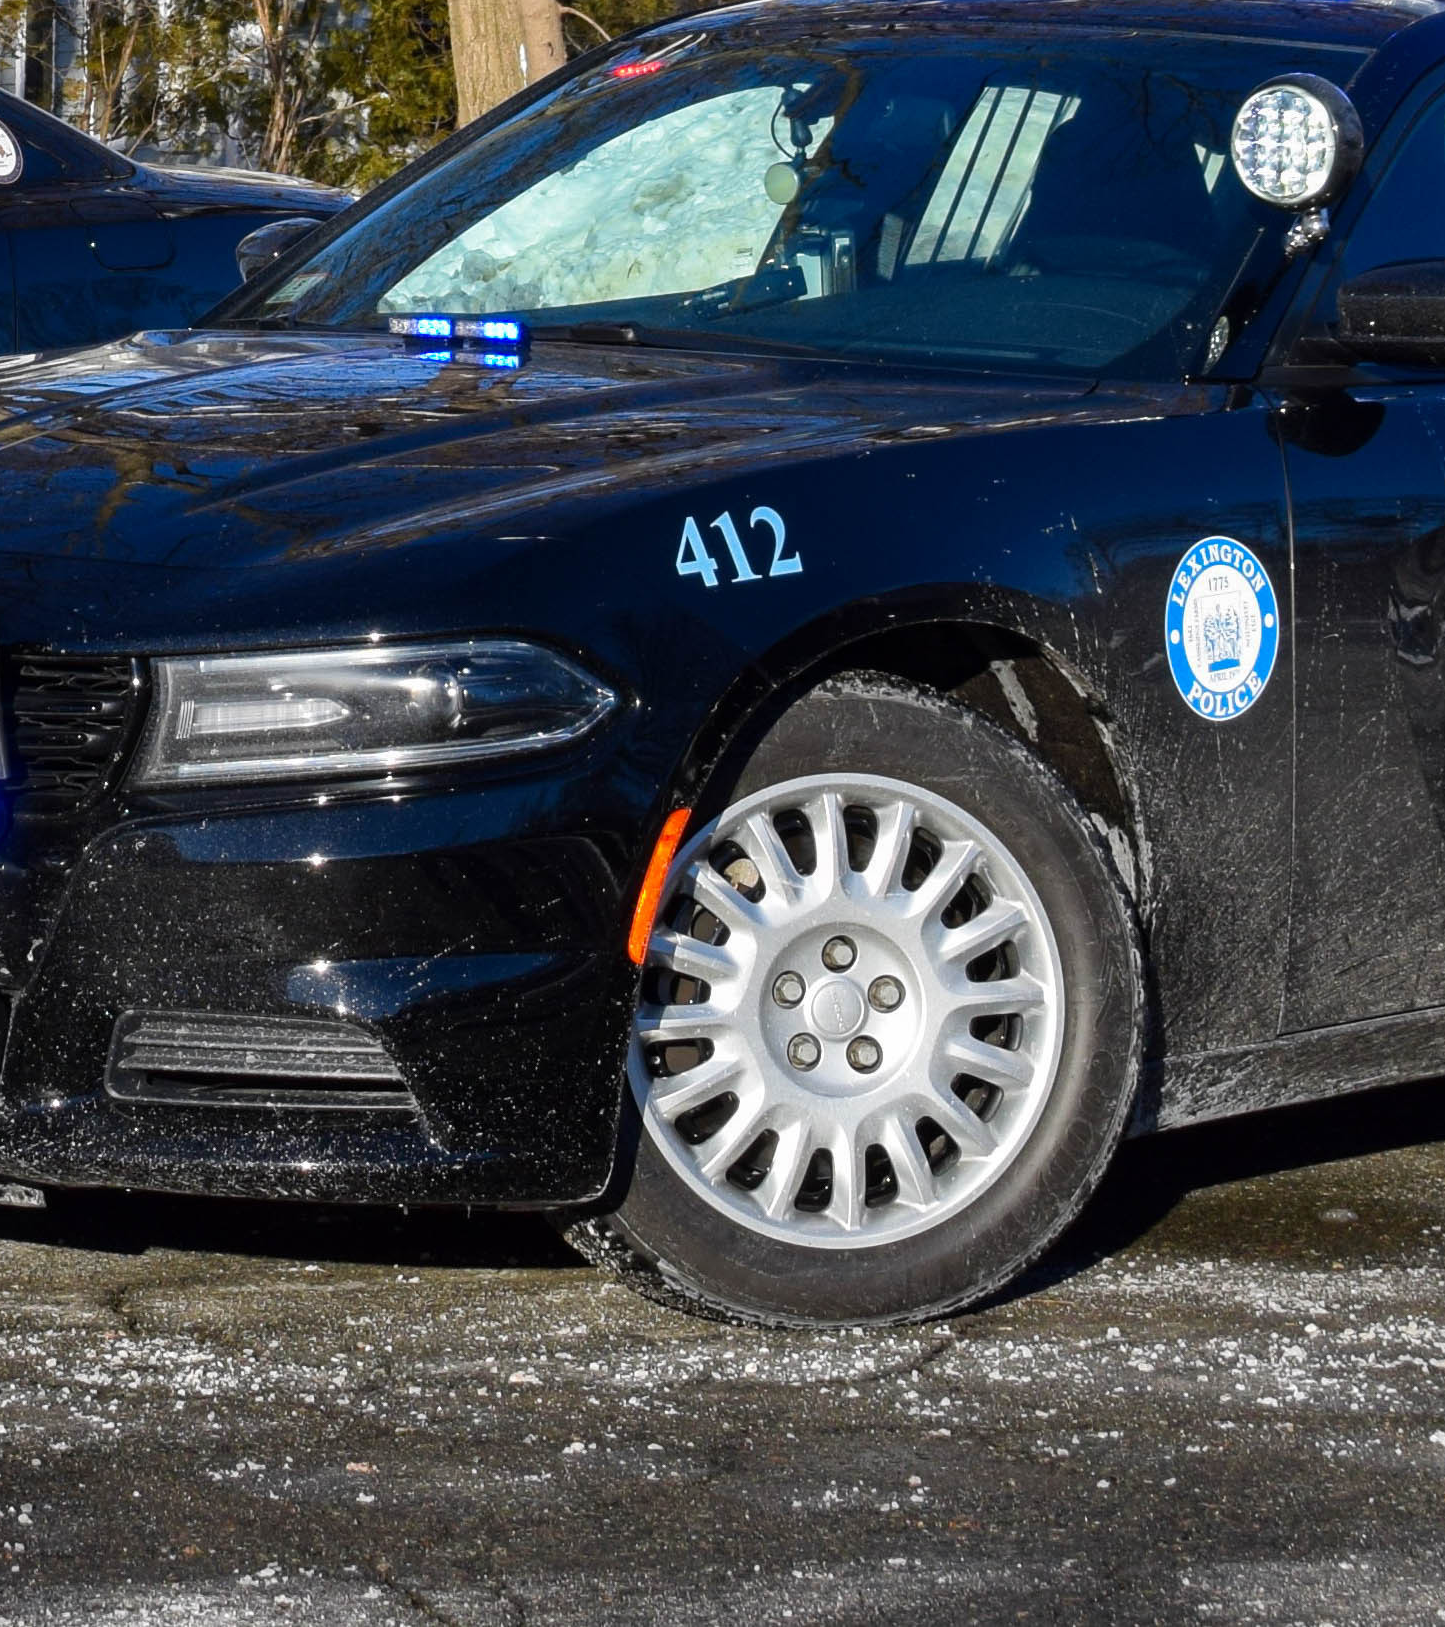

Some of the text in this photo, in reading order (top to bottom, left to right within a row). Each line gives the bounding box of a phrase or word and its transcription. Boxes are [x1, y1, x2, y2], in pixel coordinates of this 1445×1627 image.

[676, 506, 803, 587] 412
[1171, 543, 1267, 607] LEXINGTON
[1208, 576, 1229, 591] 1775
[1187, 671, 1262, 716] POLICE
